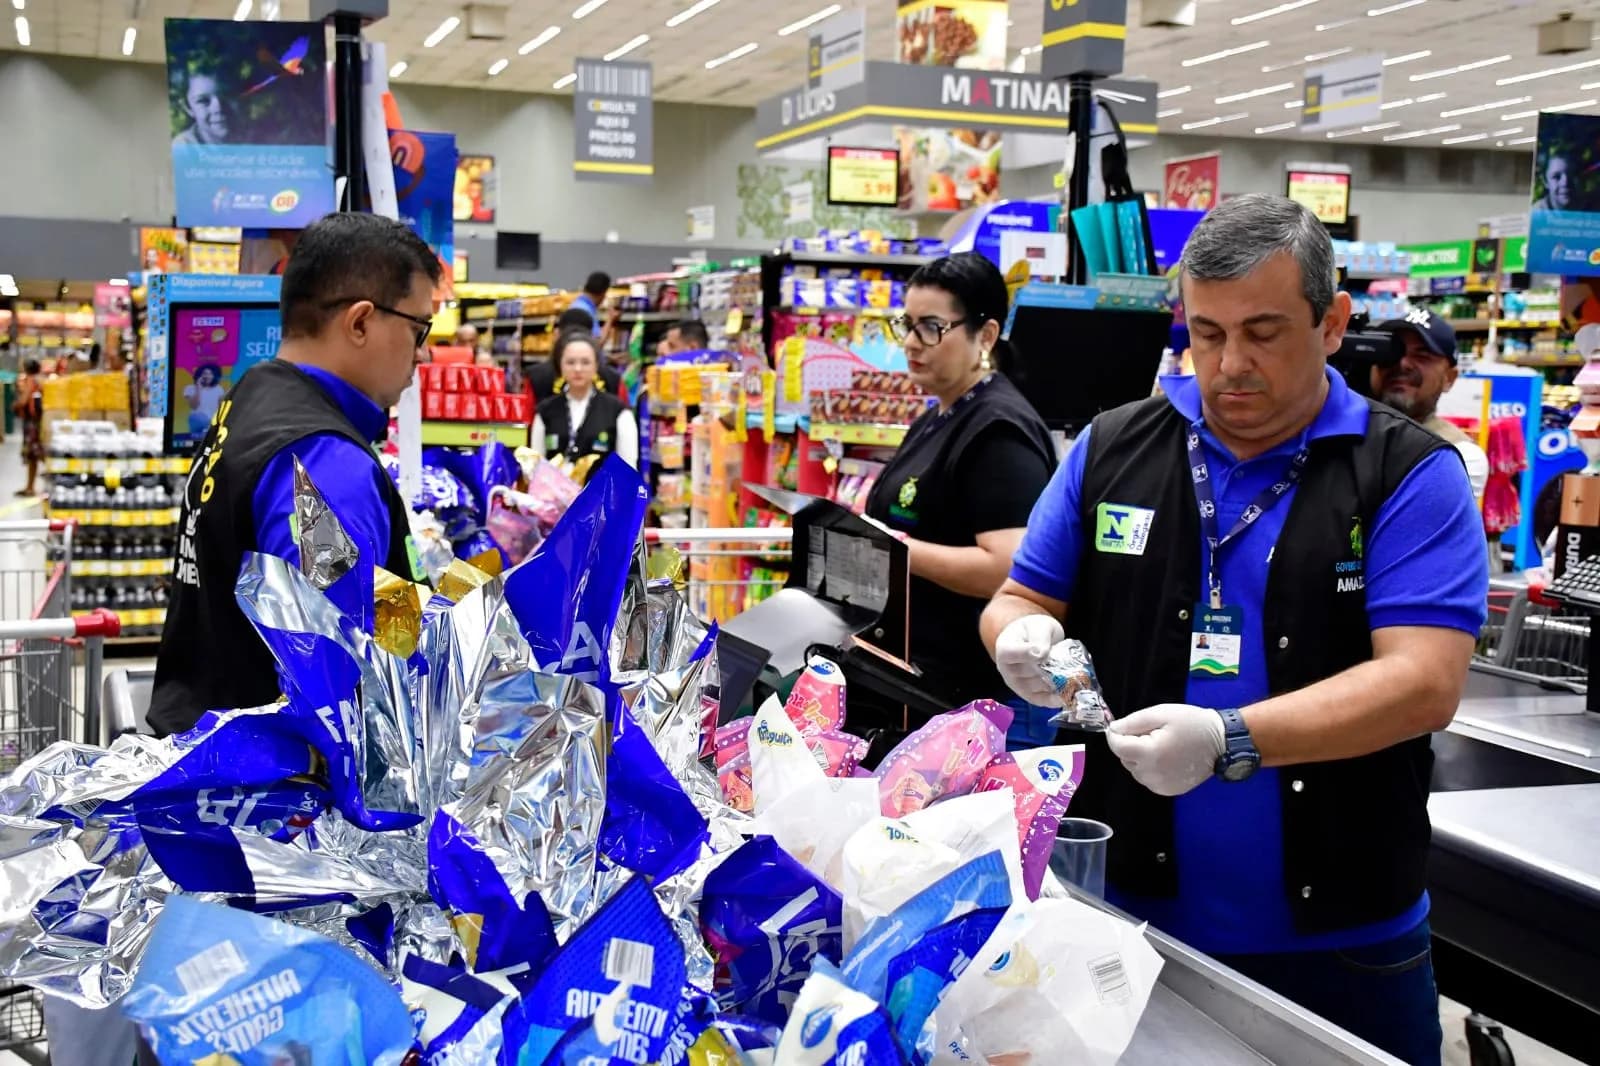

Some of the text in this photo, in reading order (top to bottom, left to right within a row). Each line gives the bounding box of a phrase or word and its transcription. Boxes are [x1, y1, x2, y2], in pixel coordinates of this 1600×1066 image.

[587, 99, 638, 115] CONSULTE
[595, 115, 619, 130] AQUI
[588, 129, 637, 145] PREÇO DO
[589, 143, 637, 160] PRODUTO
